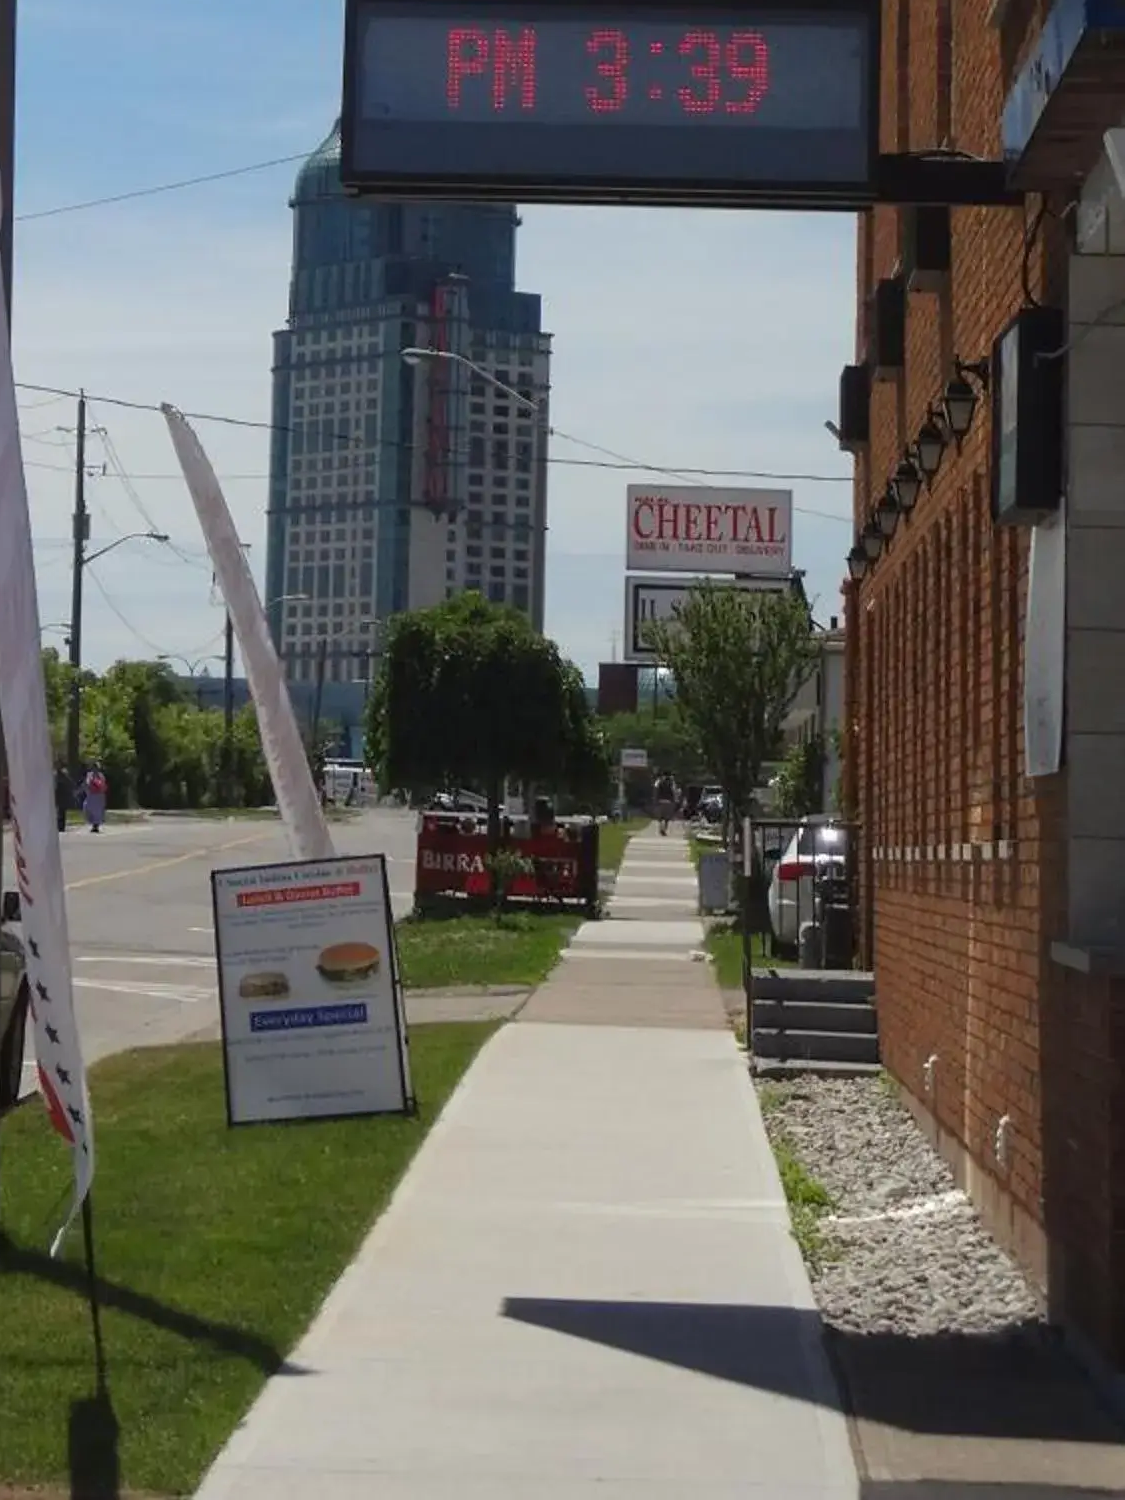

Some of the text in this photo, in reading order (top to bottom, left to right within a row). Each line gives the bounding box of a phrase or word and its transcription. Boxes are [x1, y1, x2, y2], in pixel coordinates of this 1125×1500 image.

[446, 27, 768, 115] PM 3:39
[633, 502, 786, 543] CHEETAL
[422, 850, 485, 873] BIRRA
